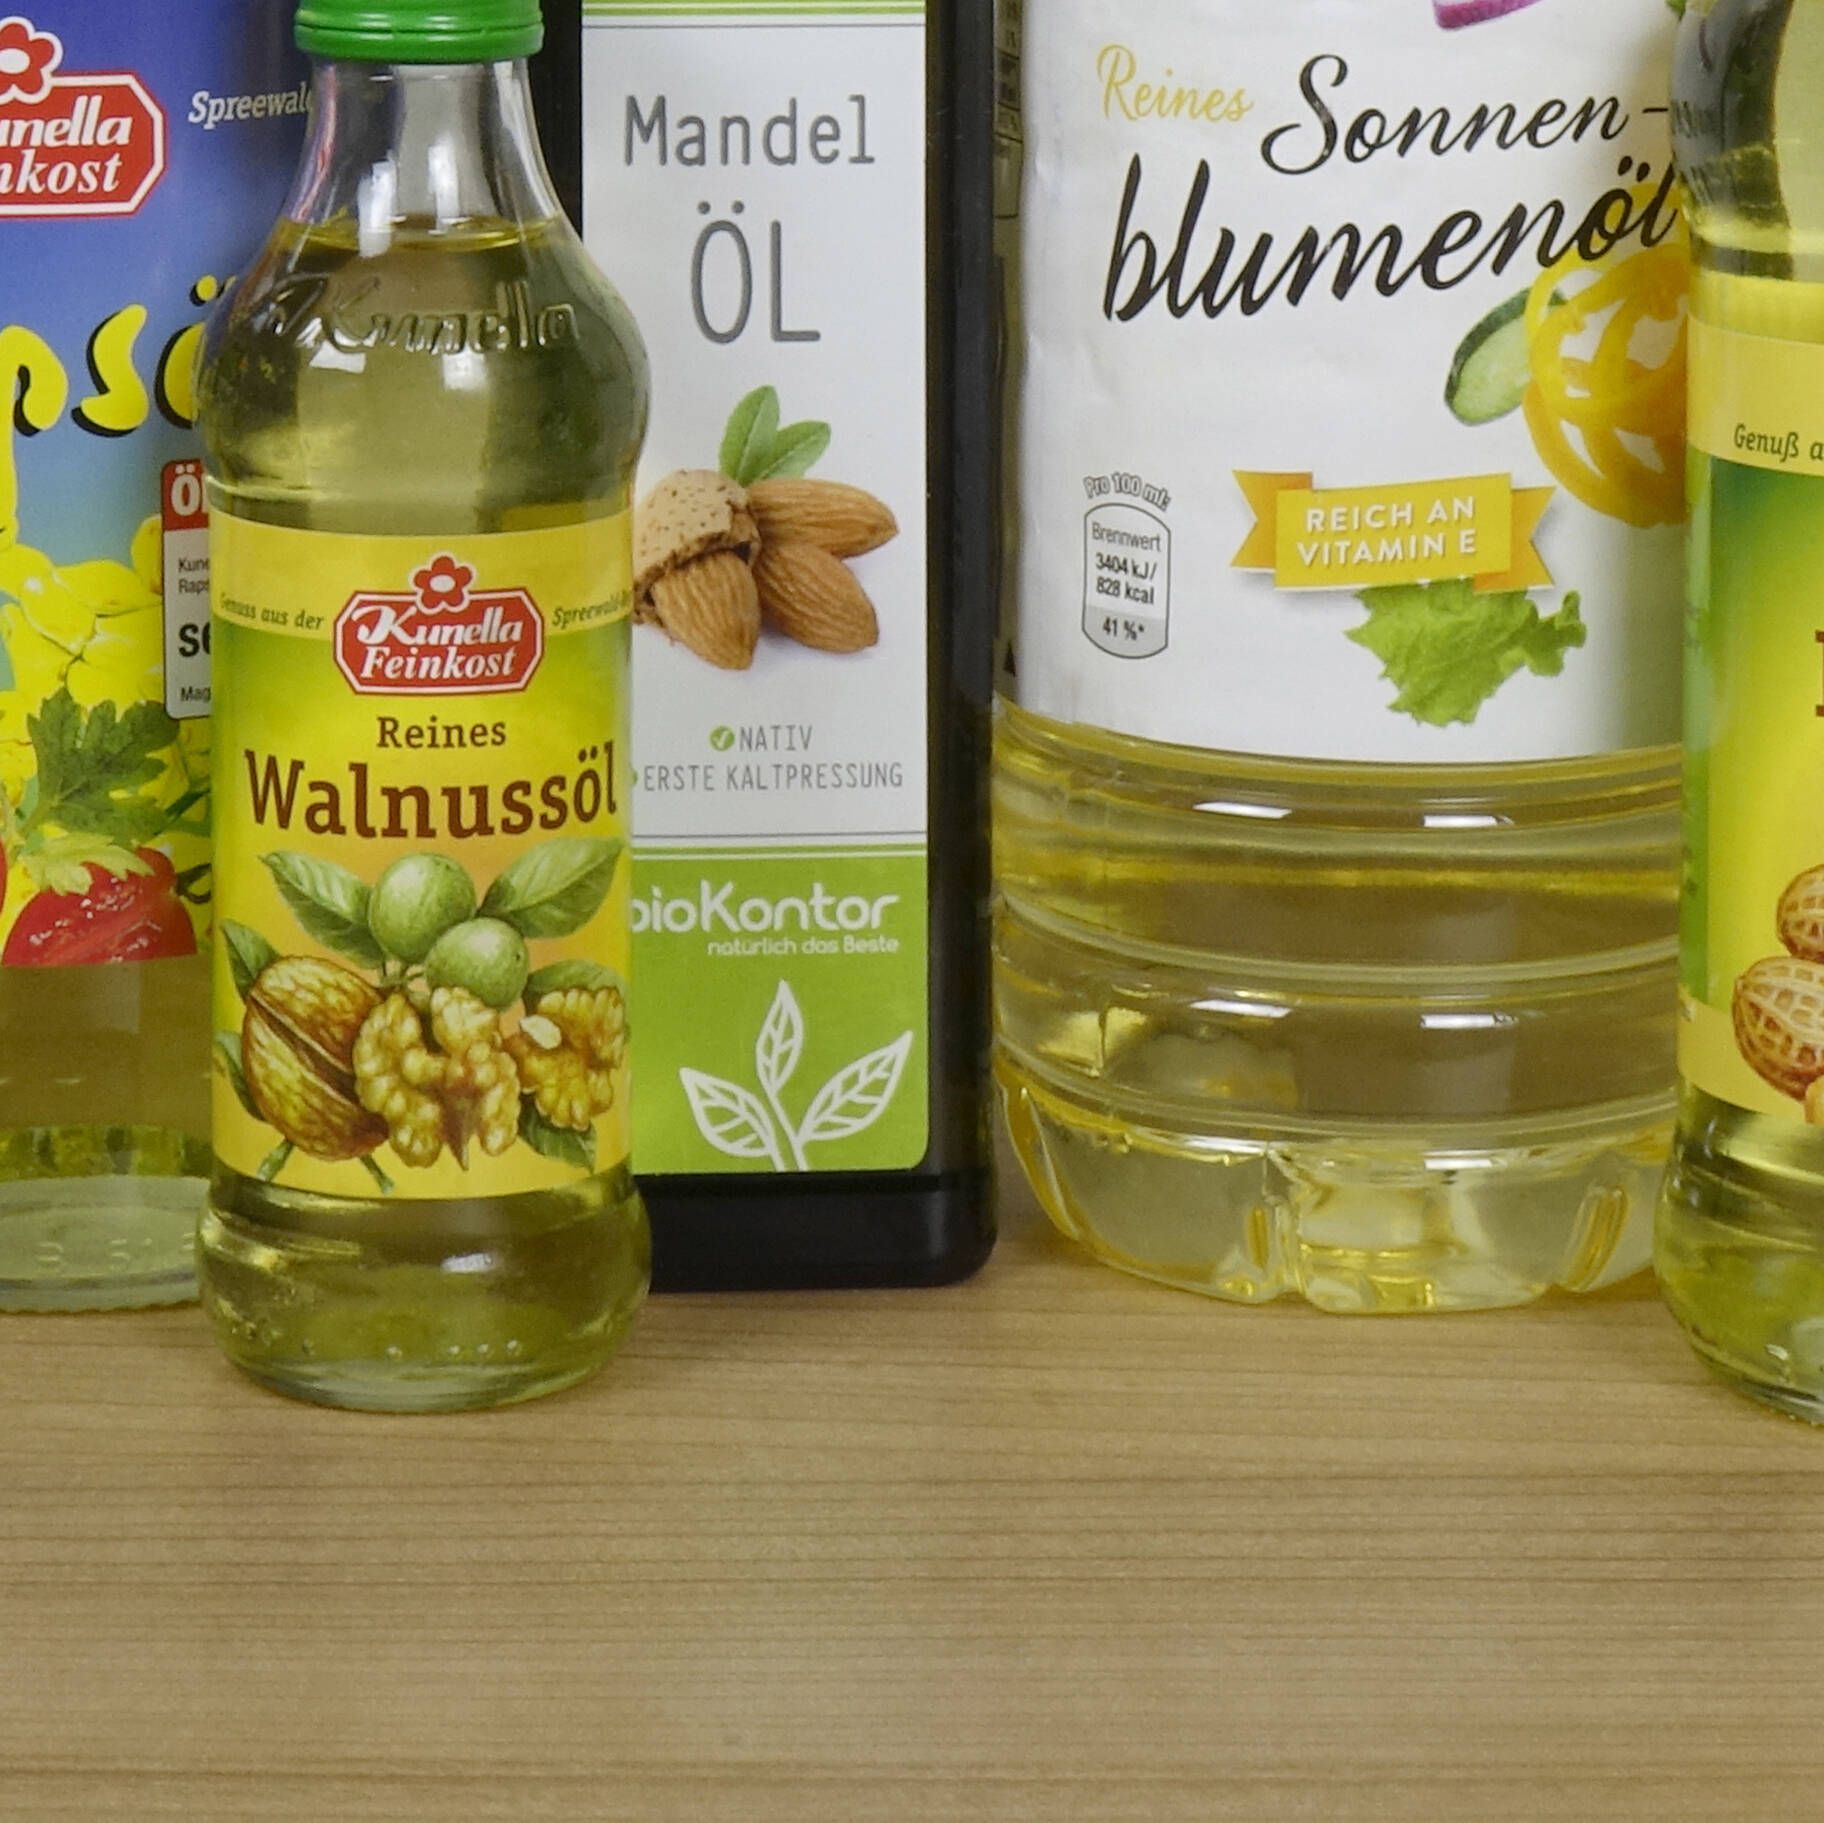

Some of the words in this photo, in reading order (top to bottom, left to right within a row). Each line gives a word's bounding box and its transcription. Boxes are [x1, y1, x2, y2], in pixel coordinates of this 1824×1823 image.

[1097, 44, 1254, 122] Reines
[1261, 54, 1670, 175] Sonnen-
[624, 95, 875, 166] Mandel
[1103, 151, 1678, 323] blumenöl
[691, 200, 821, 345] ÖL
[1733, 422, 1799, 464] Genuß
[1083, 475, 1110, 500] Pro
[1111, 472, 1142, 498] 100
[1306, 502, 1414, 533] REICH
[1426, 495, 1476, 524] AN
[1092, 521, 1162, 552] Brennwert
[1297, 535, 1446, 567] VITAMIN
[1460, 532, 1476, 555] E
[1095, 552, 1128, 575] 3404
[1125, 581, 1155, 605] kcal
[261, 607, 289, 626] aus
[295, 608, 325, 631] der
[357, 606, 523, 648] Kunella
[1102, 616, 1118, 637] 41
[362, 644, 516, 681] Feinkost
[376, 715, 507, 749] Reines
[739, 725, 814, 752] NATIV
[244, 739, 618, 840] Walnussöl
[643, 764, 715, 792] ERSTE
[726, 761, 904, 792] KALTPRESSUNG
[801, 934, 839, 955] das
[843, 934, 900, 955] Beste
